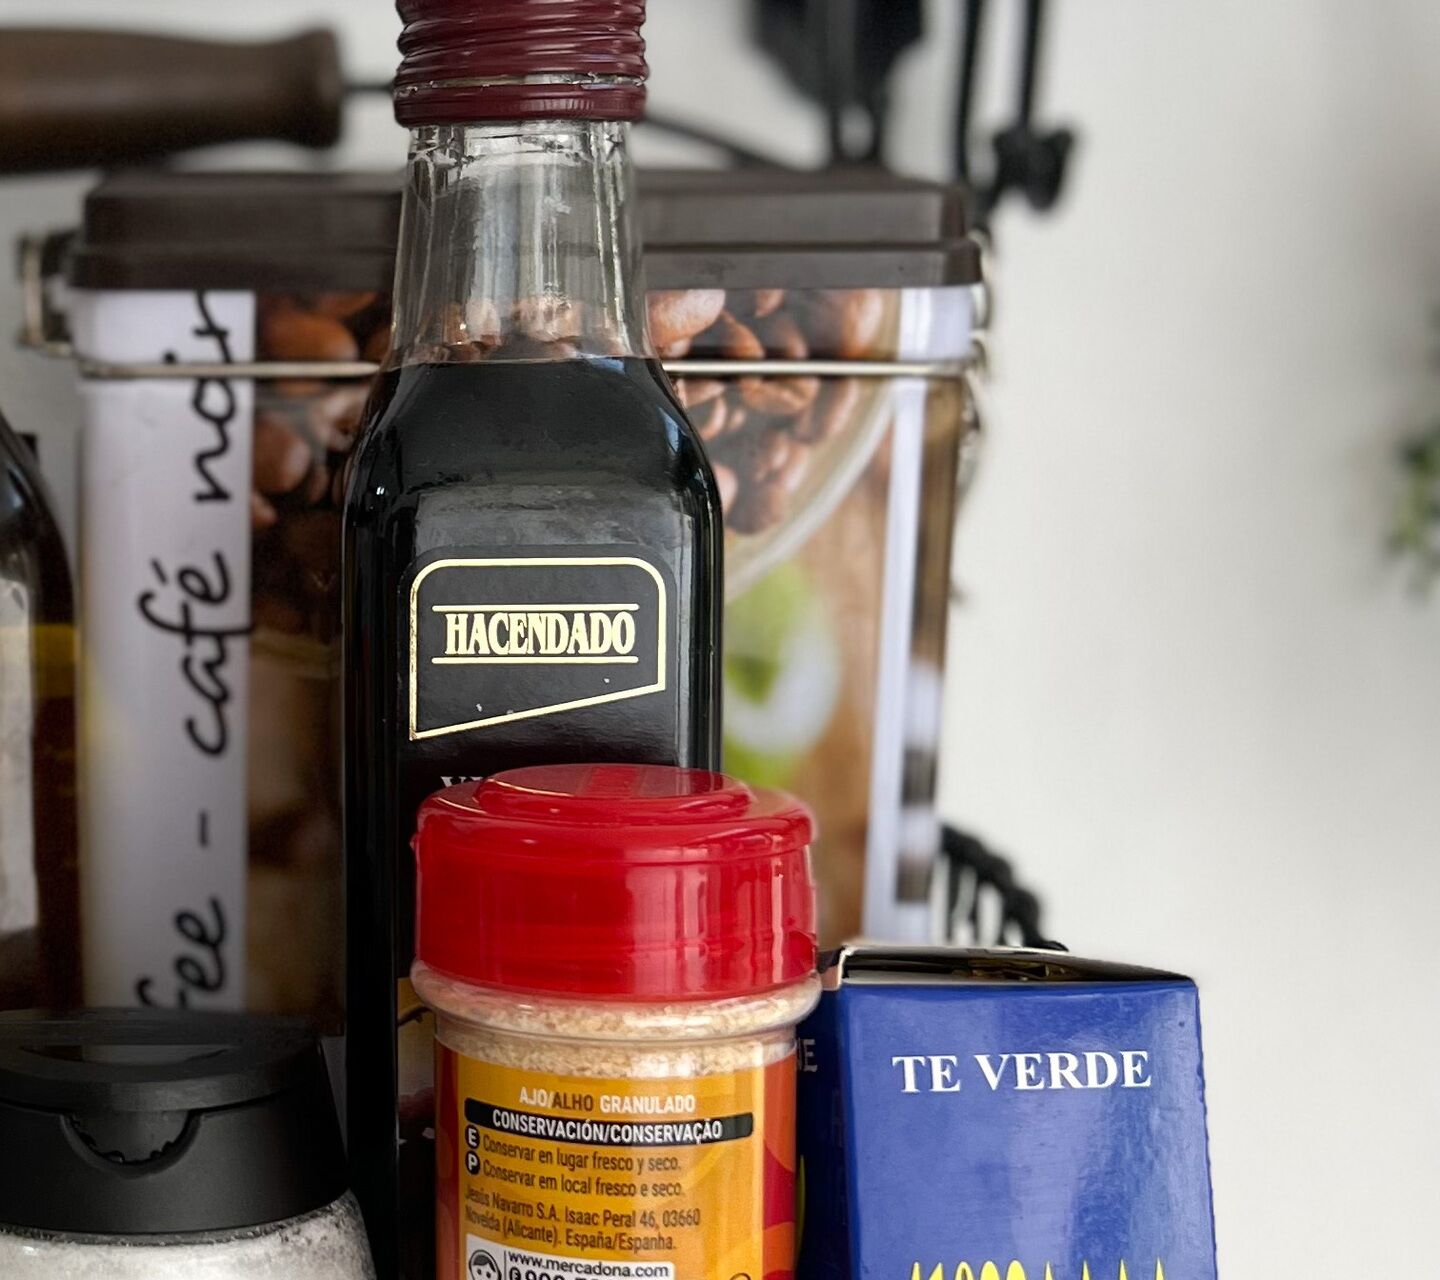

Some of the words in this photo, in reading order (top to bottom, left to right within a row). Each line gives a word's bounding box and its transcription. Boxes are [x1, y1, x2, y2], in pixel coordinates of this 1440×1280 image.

[444, 611, 636, 655] HACENDADO
[137, 552, 257, 757] café
[892, 1055, 961, 1093] TE
[974, 1050, 1152, 1091] VERDE
[519, 1086, 593, 1112] AJO/ALHO
[599, 1094, 695, 1113] GRANULADO
[492, 1109, 723, 1144] CONSERVACIÓN/CONSERVAÇÃO
[483, 1134, 535, 1161] Conservar
[539, 1148, 553, 1163] en
[556, 1144, 589, 1169] lugar
[592, 1150, 634, 1170] fresco
[637, 1156, 645, 1174] y
[648, 1156, 681, 1171] seco.
[483, 1160, 535, 1188] Conservar
[539, 1173, 557, 1190] em
[560, 1172, 591, 1195] local
[595, 1179, 637, 1197] fresco
[640, 1183, 648, 1196] e
[651, 1181, 685, 1196] seco.
[492, 1191, 534, 1218] Navarro
[536, 1201, 561, 1221] S.A.
[564, 1207, 598, 1225] Isaac
[602, 1210, 636, 1228] Peral
[565, 1228, 677, 1251] España/Espanha.
[509, 1250, 669, 1278] www.mercadona.com
